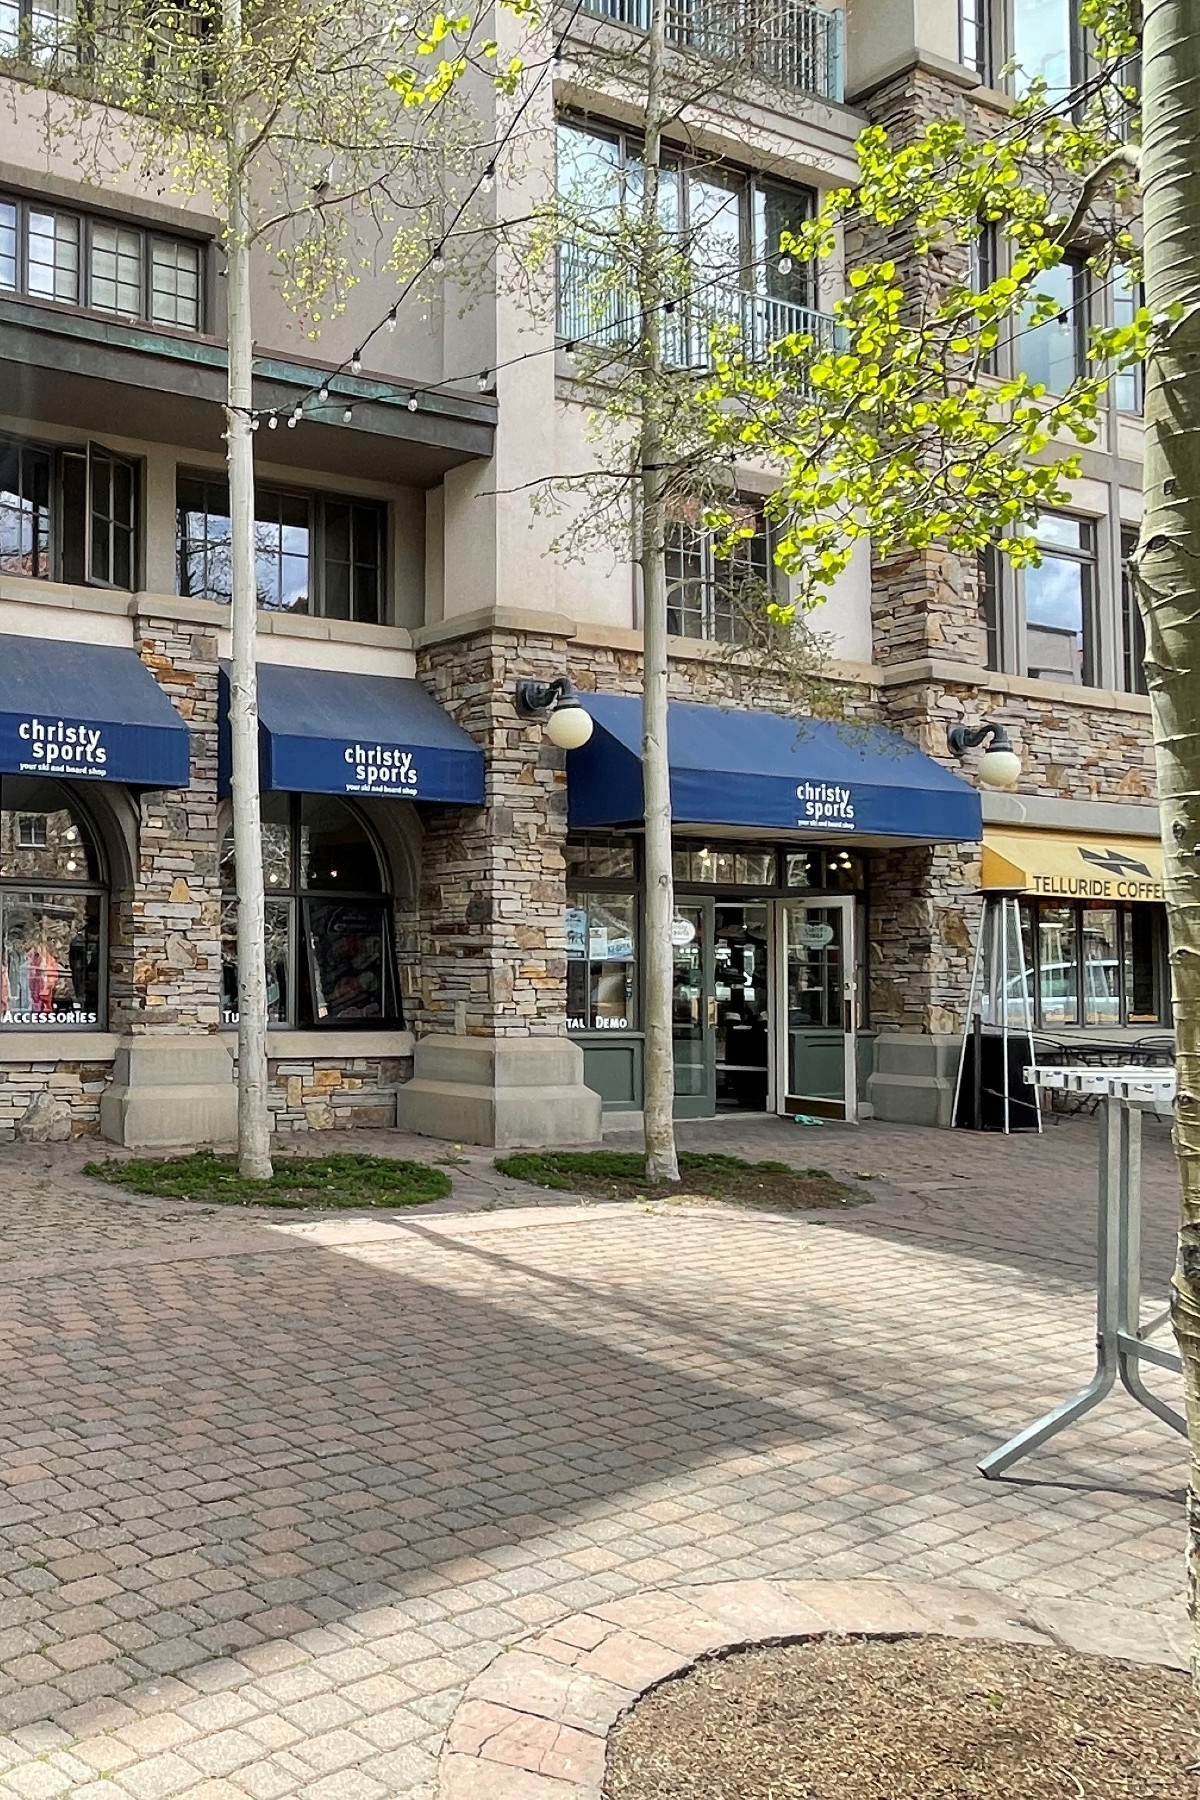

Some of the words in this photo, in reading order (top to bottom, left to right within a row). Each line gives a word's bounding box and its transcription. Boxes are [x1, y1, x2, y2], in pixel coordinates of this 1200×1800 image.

[18, 718, 101, 751] christy
[32, 742, 107, 764] sports
[344, 744, 413, 773] christy
[355, 765, 418, 785] sports
[796, 781, 851, 809] christy
[805, 801, 855, 820] sports
[1032, 875, 1112, 897] TELLURIDE
[1, 1010, 97, 1024] ACCESSORIES
